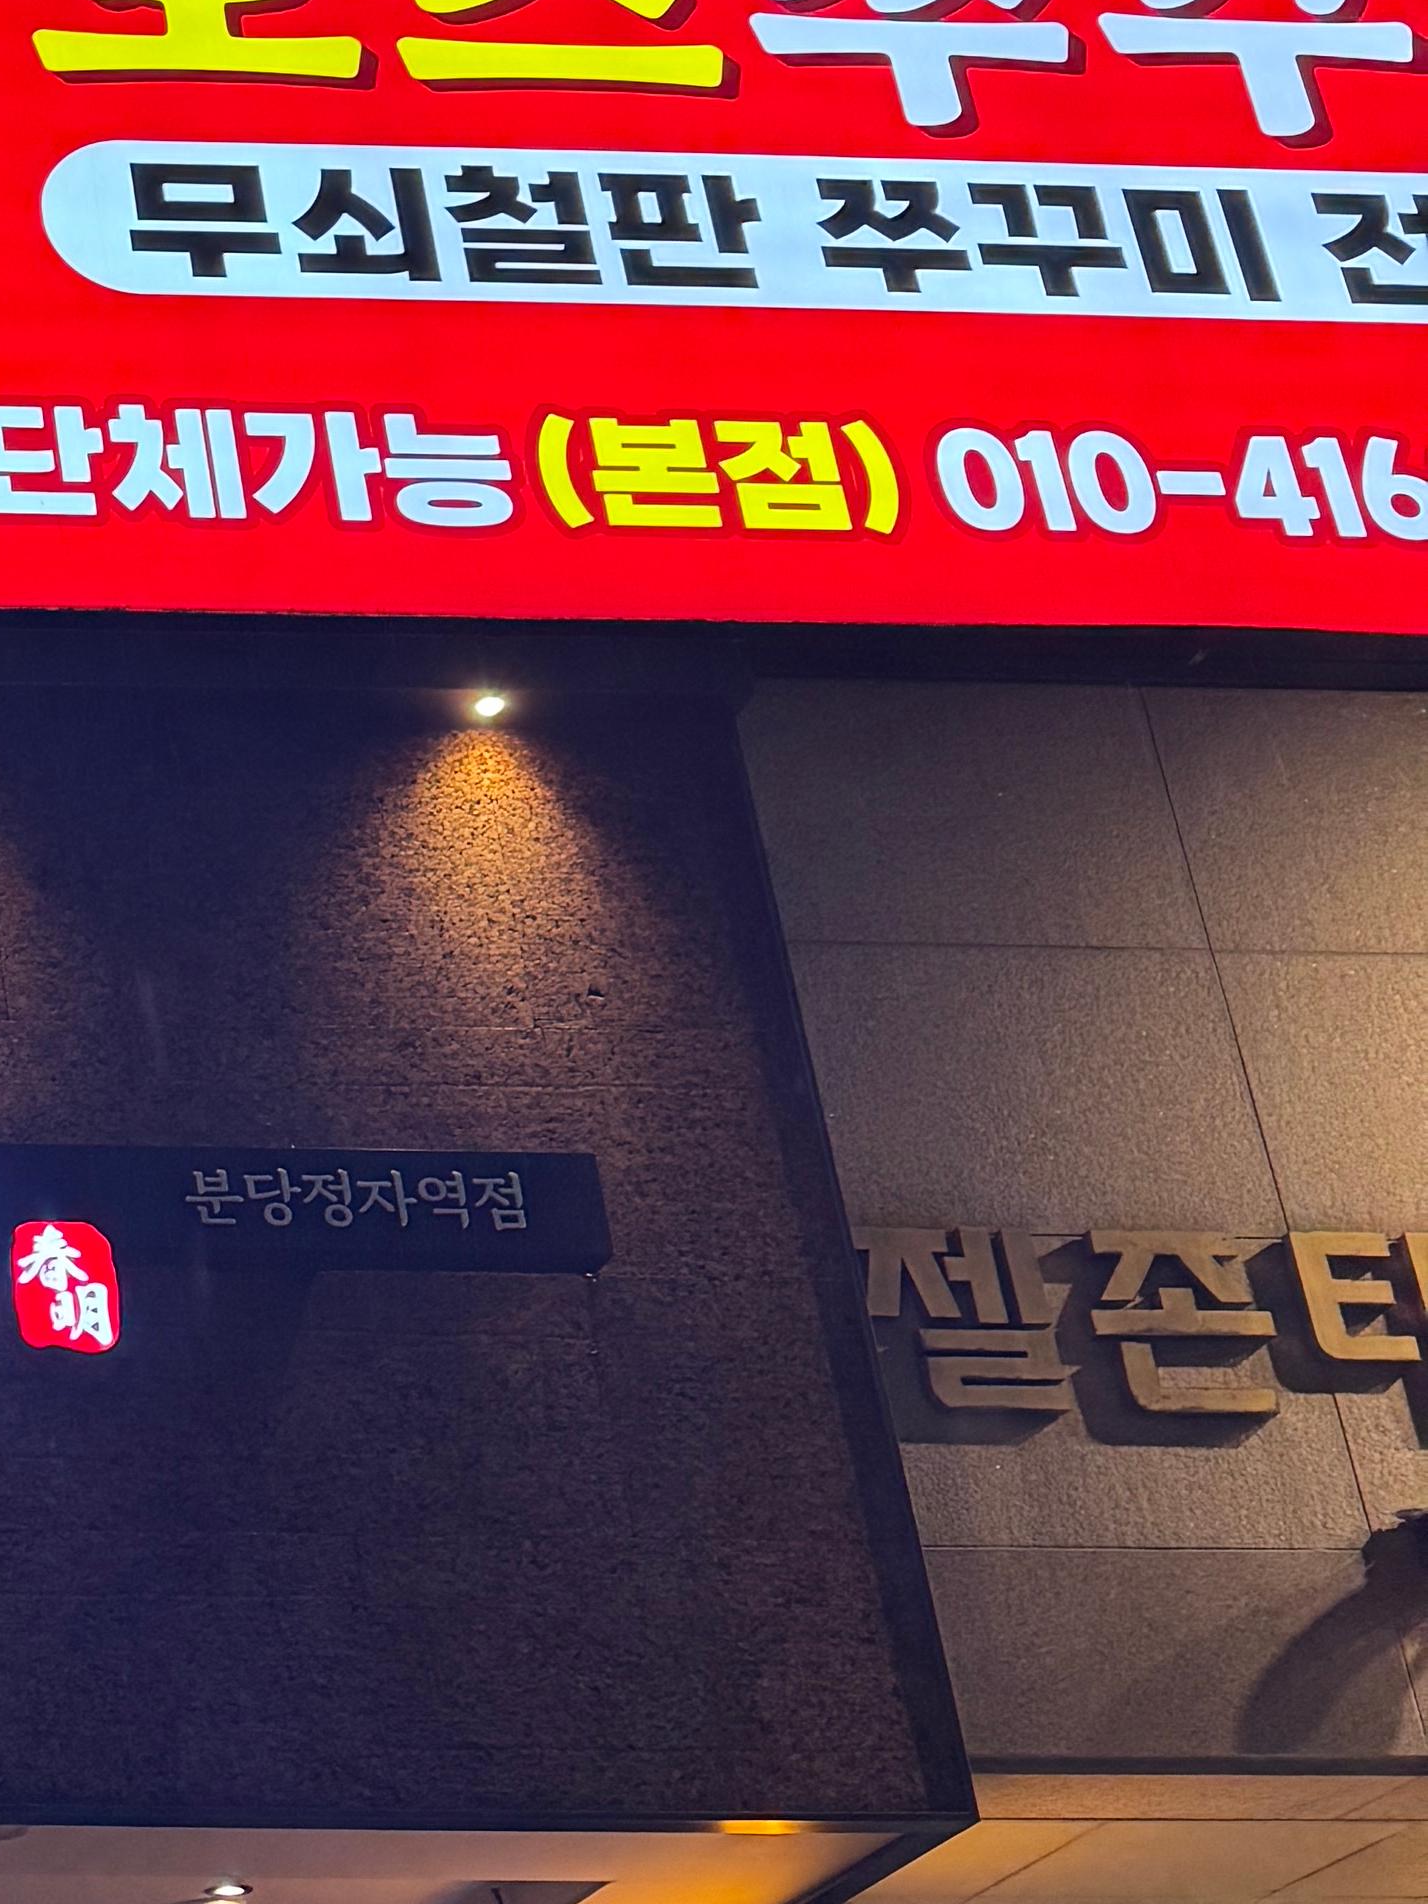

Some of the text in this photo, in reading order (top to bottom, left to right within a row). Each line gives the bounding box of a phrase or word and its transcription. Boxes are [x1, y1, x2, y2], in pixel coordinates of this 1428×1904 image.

[128, 163, 762, 289] 무쇠철판
[816, 179, 1281, 302] 쭈꾸미
[185, 1168, 528, 1232] 분당정자역점
[16, 1223, 114, 1349] 春明
